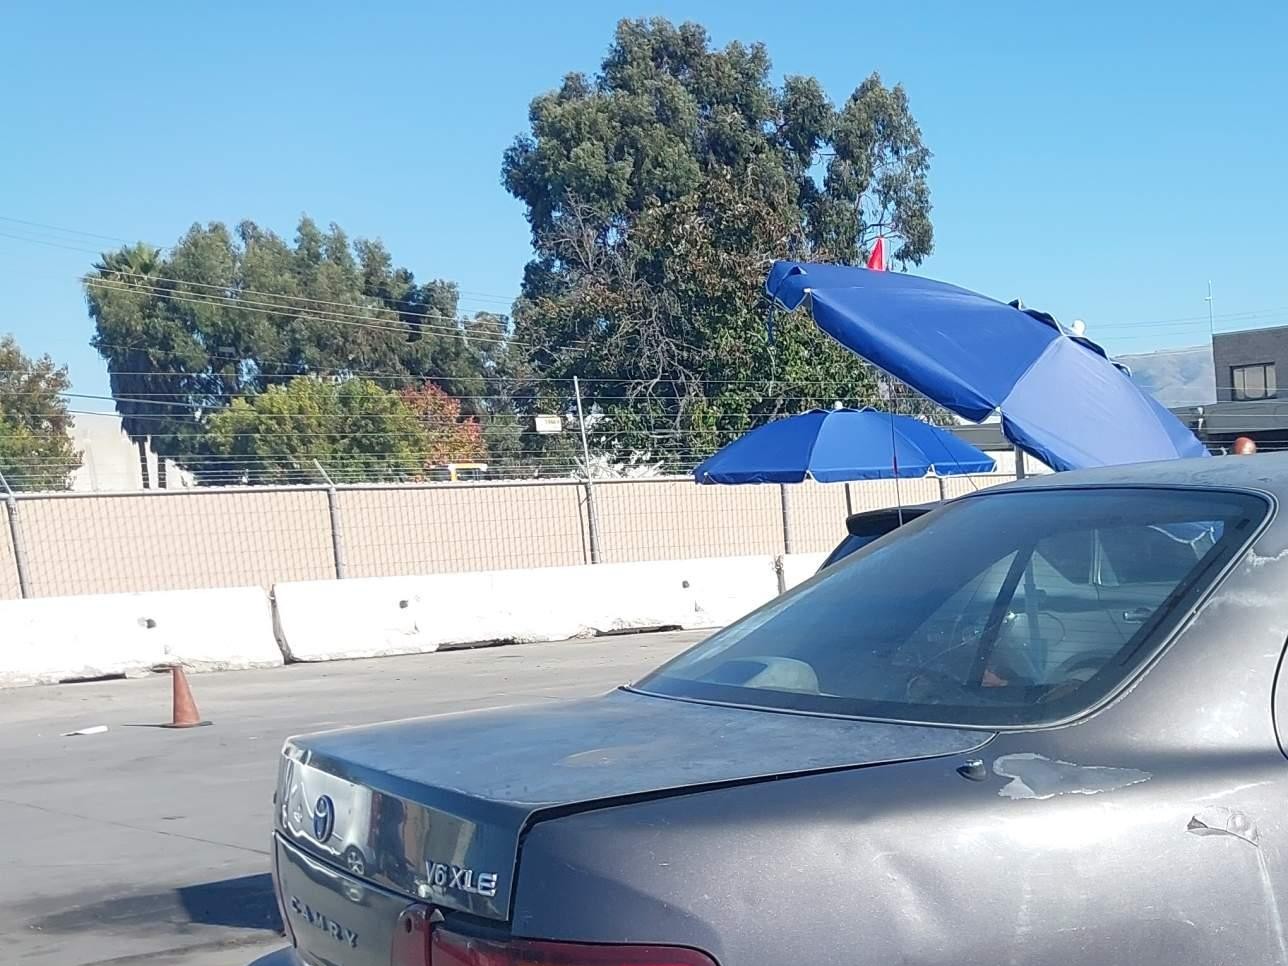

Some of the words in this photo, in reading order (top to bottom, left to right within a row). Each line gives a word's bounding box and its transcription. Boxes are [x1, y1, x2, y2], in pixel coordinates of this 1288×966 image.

[425, 860, 448, 886] V6
[449, 866, 498, 897] XLE
[290, 895, 359, 948] CAMRY
